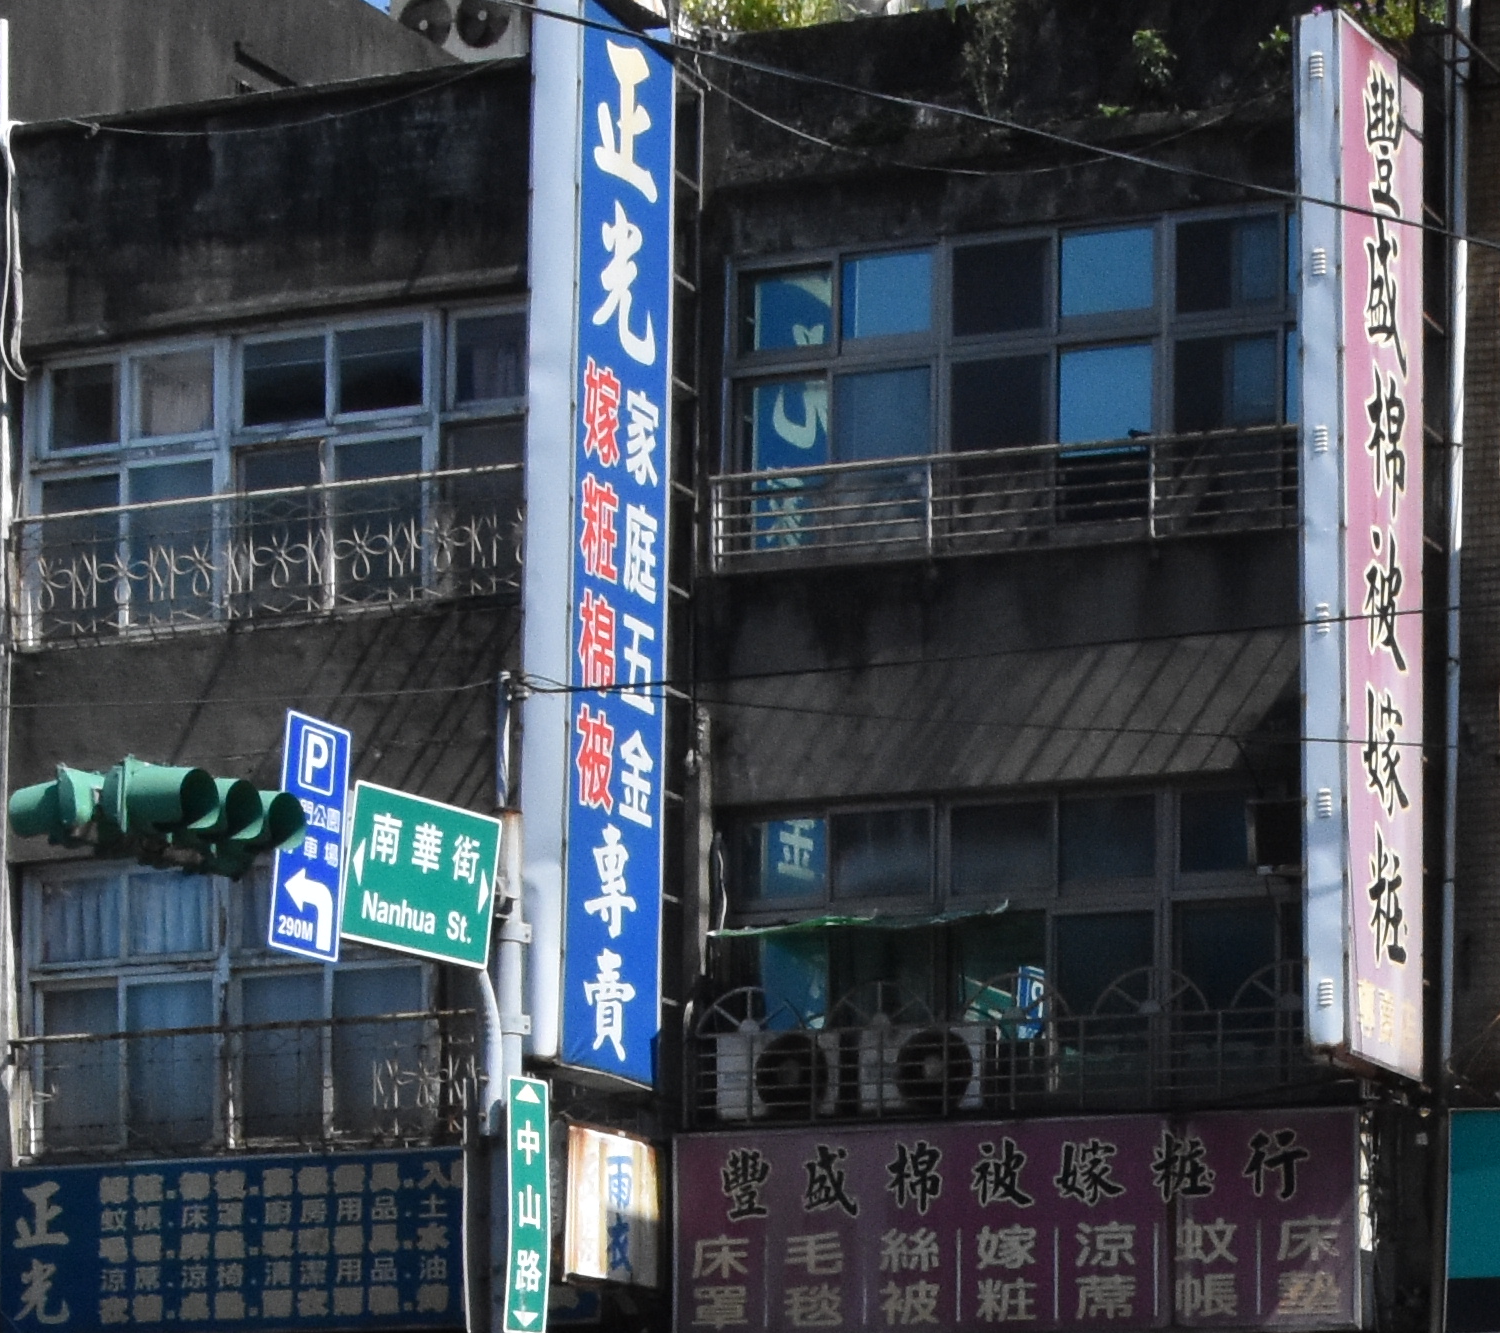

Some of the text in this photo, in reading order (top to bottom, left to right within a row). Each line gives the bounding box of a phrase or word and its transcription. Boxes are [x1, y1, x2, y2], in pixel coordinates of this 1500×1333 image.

[593, 39, 658, 366] 正光
[618, 389, 660, 829] 家庭五金
[283, 836, 339, 868] 車場
[370, 812, 481, 885] 南華街
[278, 914, 314, 942] 290M
[362, 890, 473, 945] Nanhua St.
[583, 822, 637, 1062] 專賣
[13, 1180, 70, 1325] 正光
[515, 1120, 542, 1292] 中山路
[691, 1232, 749, 1332] 床罩
[783, 1230, 846, 1328] 毛毯
